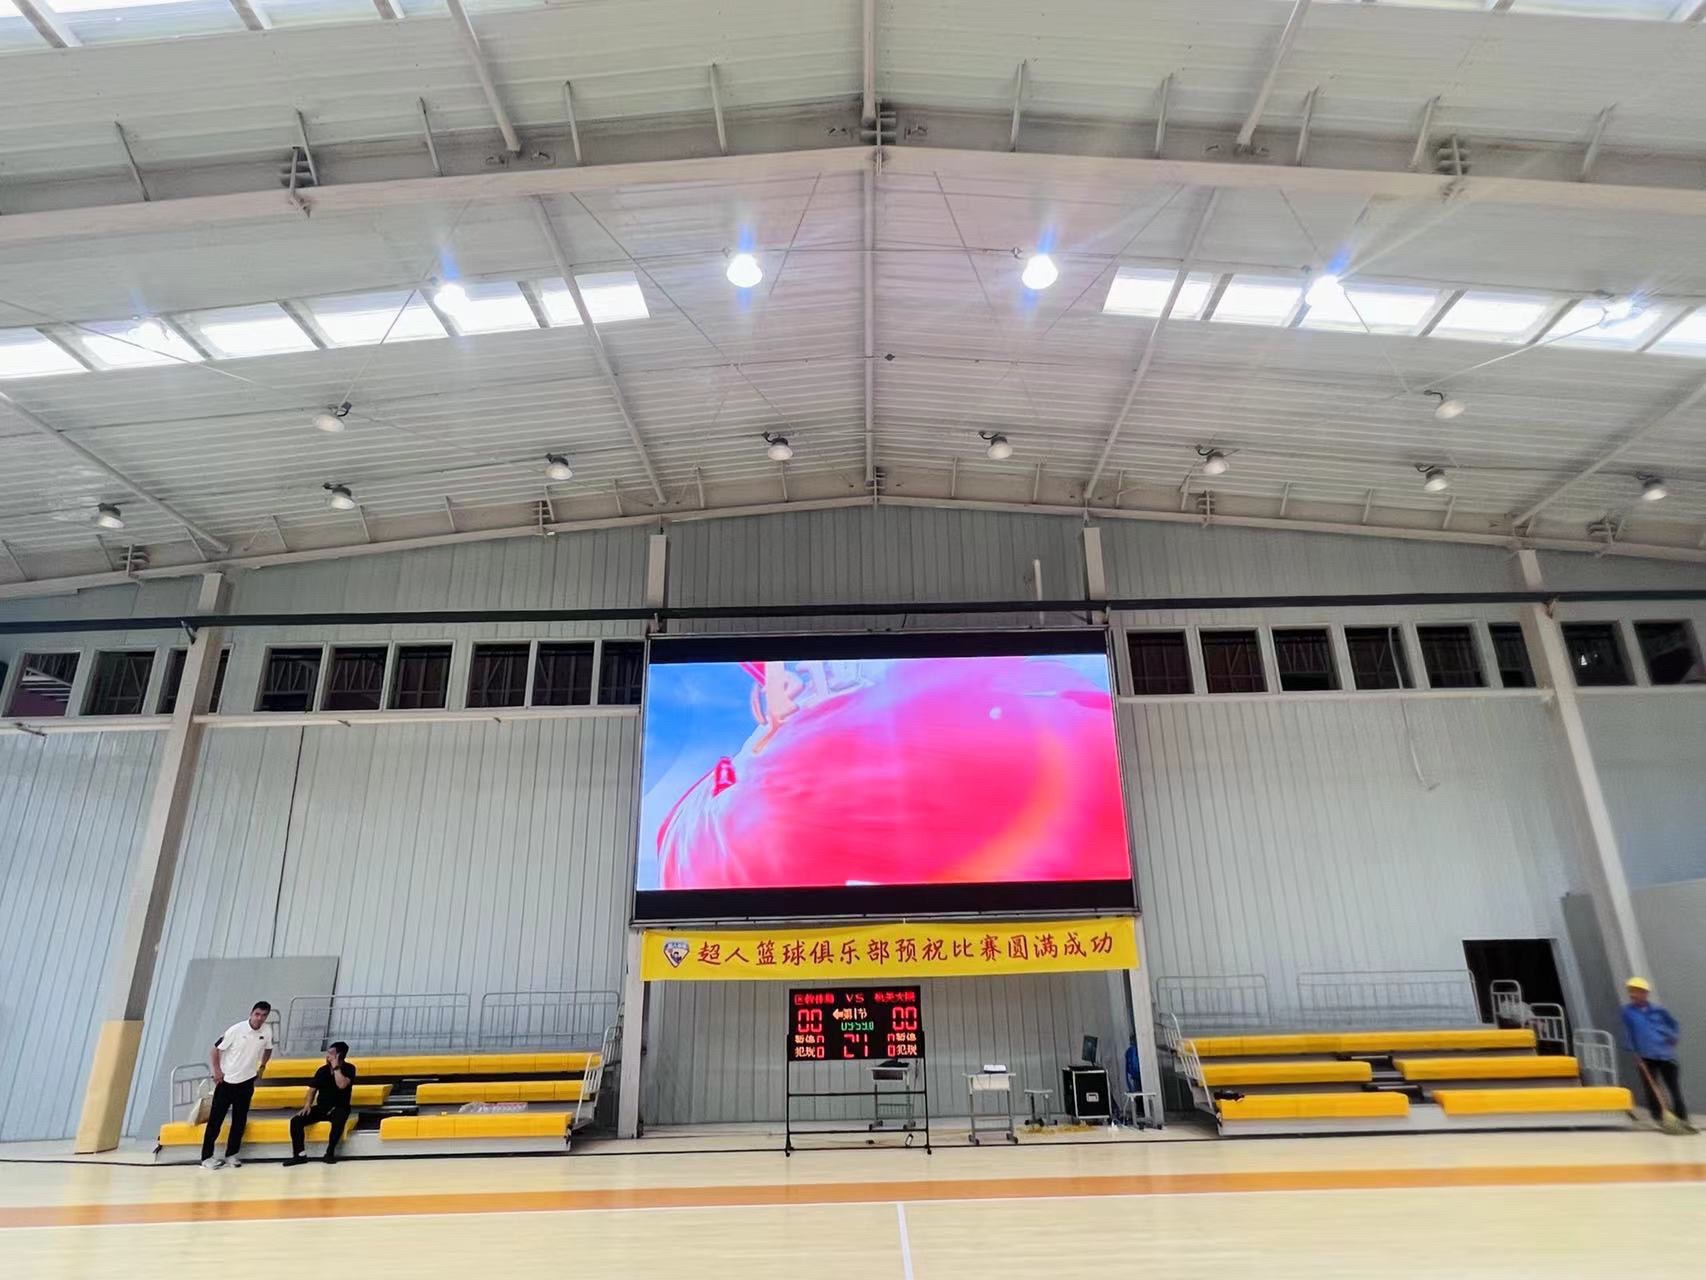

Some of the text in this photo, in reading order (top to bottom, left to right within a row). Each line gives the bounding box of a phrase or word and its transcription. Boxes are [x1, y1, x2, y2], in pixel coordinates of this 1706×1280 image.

[697, 931, 1113, 966] 超人篮球俱乐部预祝比赛圆满成功
[845, 993, 865, 1003] VS
[798, 1009, 823, 1033] 00
[892, 1006, 918, 1031] 00
